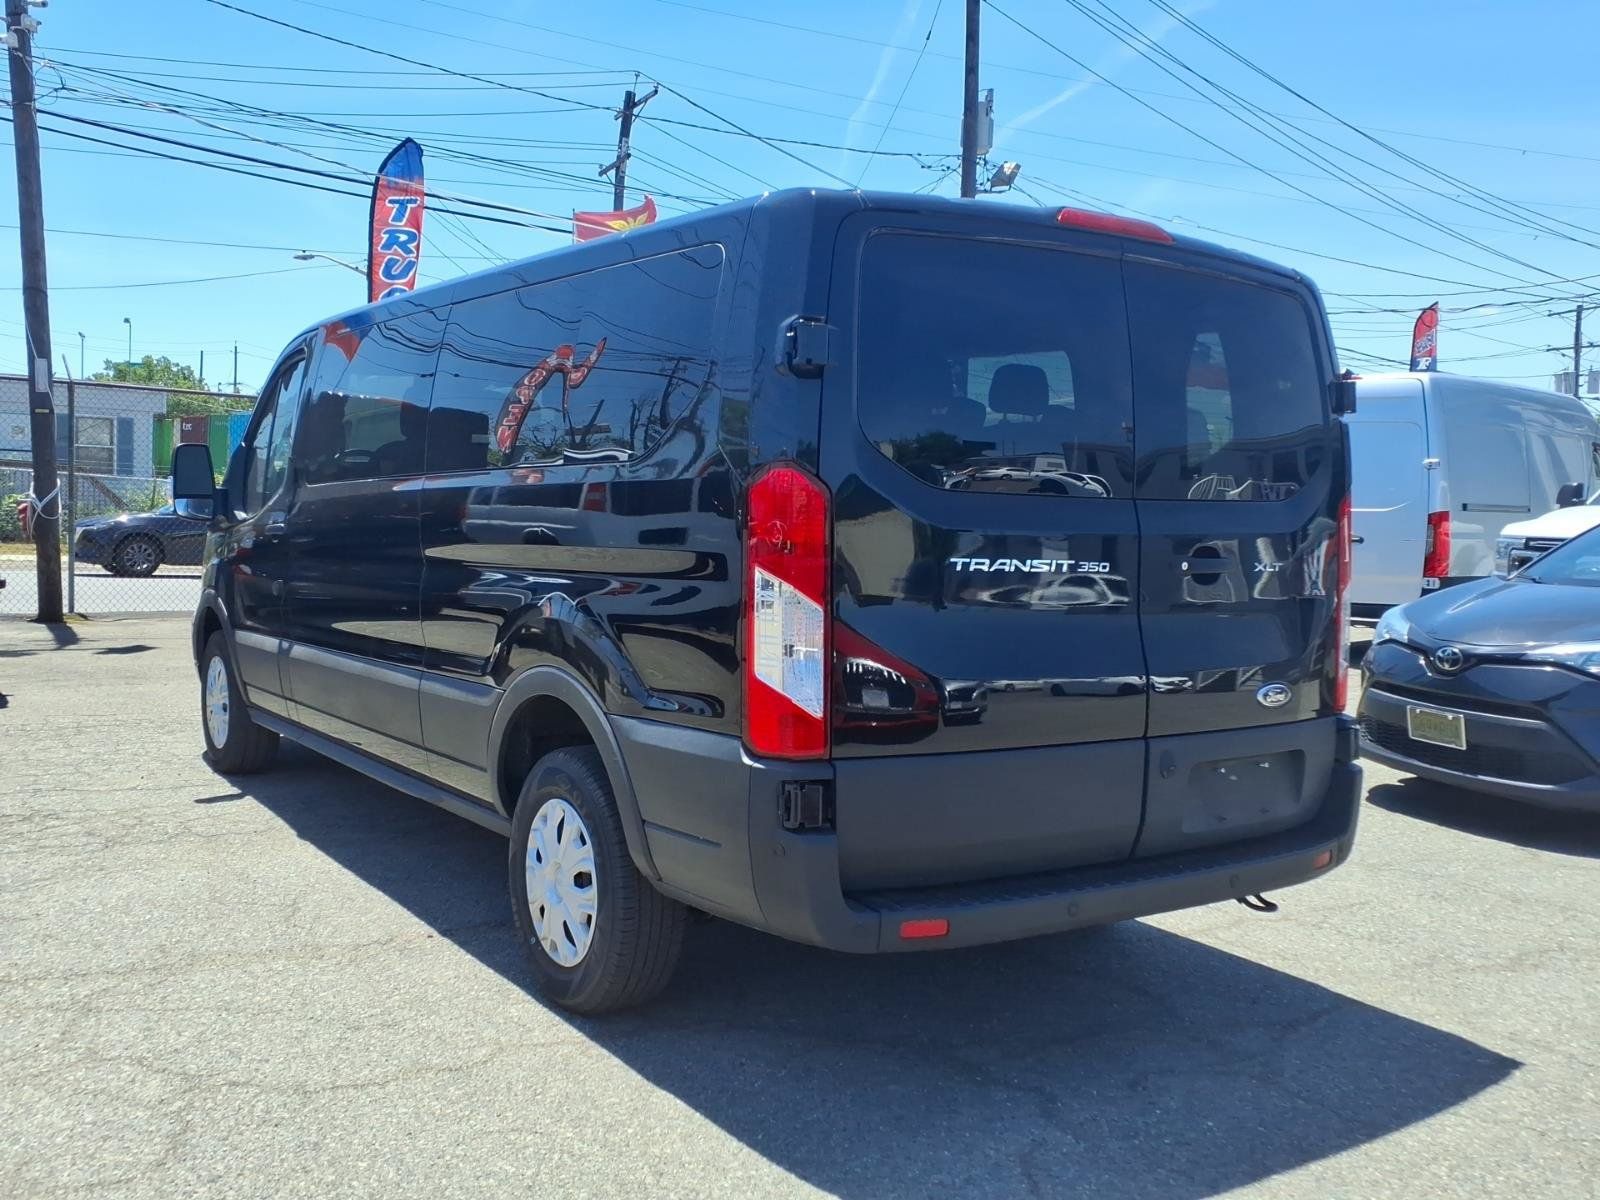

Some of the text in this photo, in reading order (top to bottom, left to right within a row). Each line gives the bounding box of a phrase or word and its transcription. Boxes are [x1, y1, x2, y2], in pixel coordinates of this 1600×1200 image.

[950, 558, 1111, 573] TRANSIT 350
[1253, 562, 1284, 572] XLT
